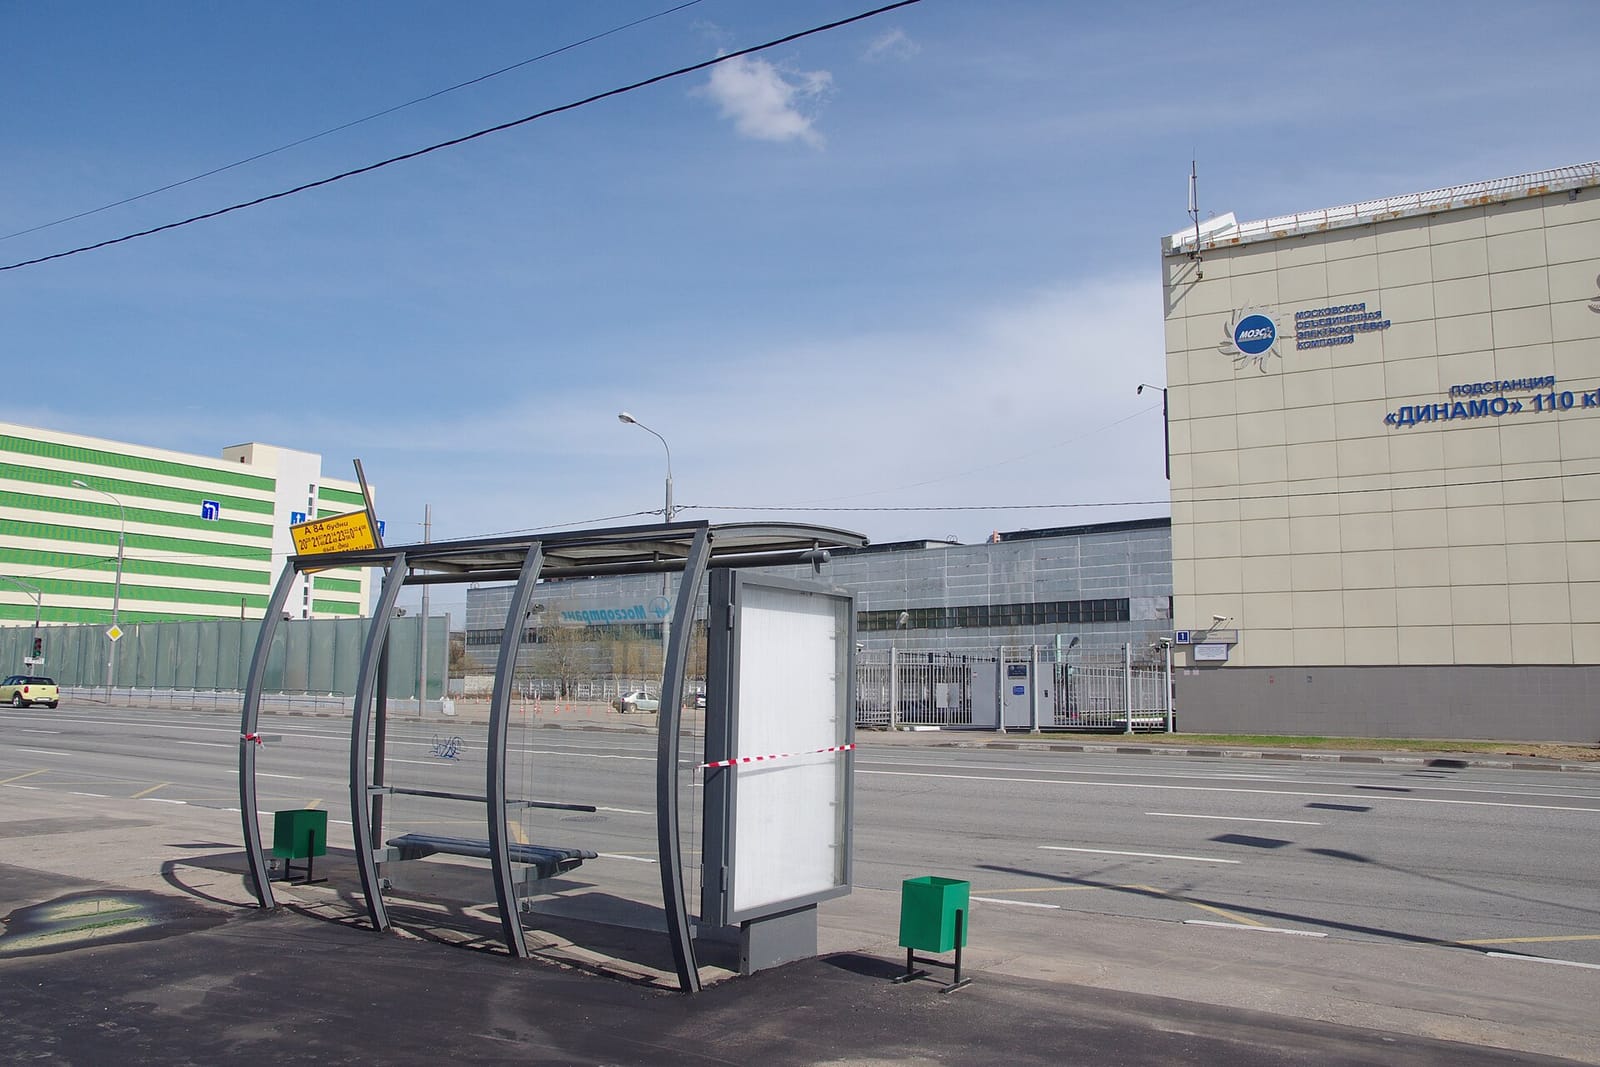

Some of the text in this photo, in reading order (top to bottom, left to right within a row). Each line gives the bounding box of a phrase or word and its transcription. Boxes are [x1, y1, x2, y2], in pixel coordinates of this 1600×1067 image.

[1295, 303, 1366, 320] МОСКОВСКАЯ
[1295, 311, 1382, 330] ОБЪЕДИНЕННАЯ
[1296, 320, 1391, 340] ЭЛЕКТРОСЕТЕВАЯ
[1296, 335, 1354, 350] КОМПАНИЯ
[1450, 375, 1555, 397] ПОДСТАНЦИЯ
[1384, 397, 1523, 429] «ДИНАМО»
[1532, 391, 1574, 412] 110
[313, 524, 324, 533] 84
[327, 521, 348, 531] будни
